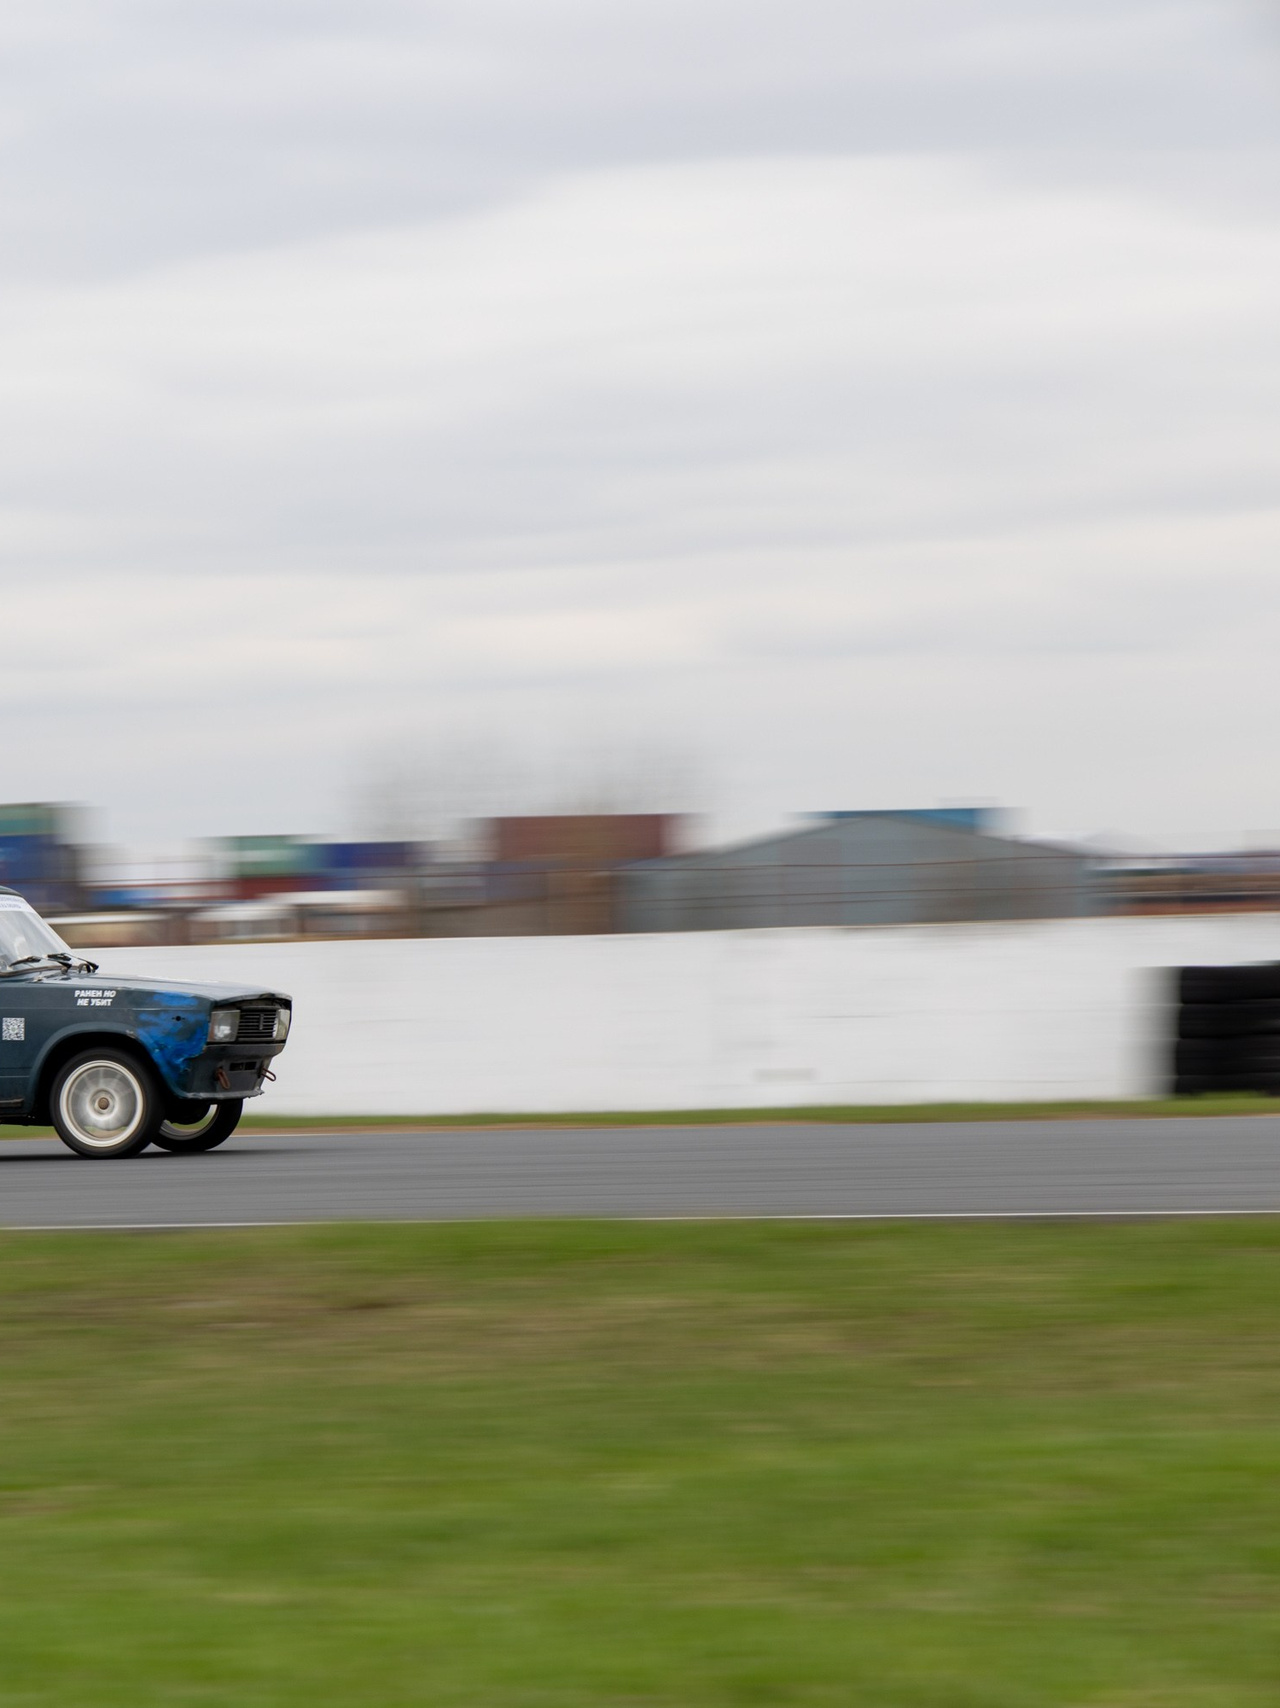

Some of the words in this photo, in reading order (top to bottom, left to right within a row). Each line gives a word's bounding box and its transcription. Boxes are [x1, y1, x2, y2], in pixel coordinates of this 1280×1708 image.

[74, 990, 102, 998] РАНЕН
[103, 990, 117, 998] НО
[77, 998, 89, 1006] НЕ
[90, 998, 113, 1006] УБИТ
